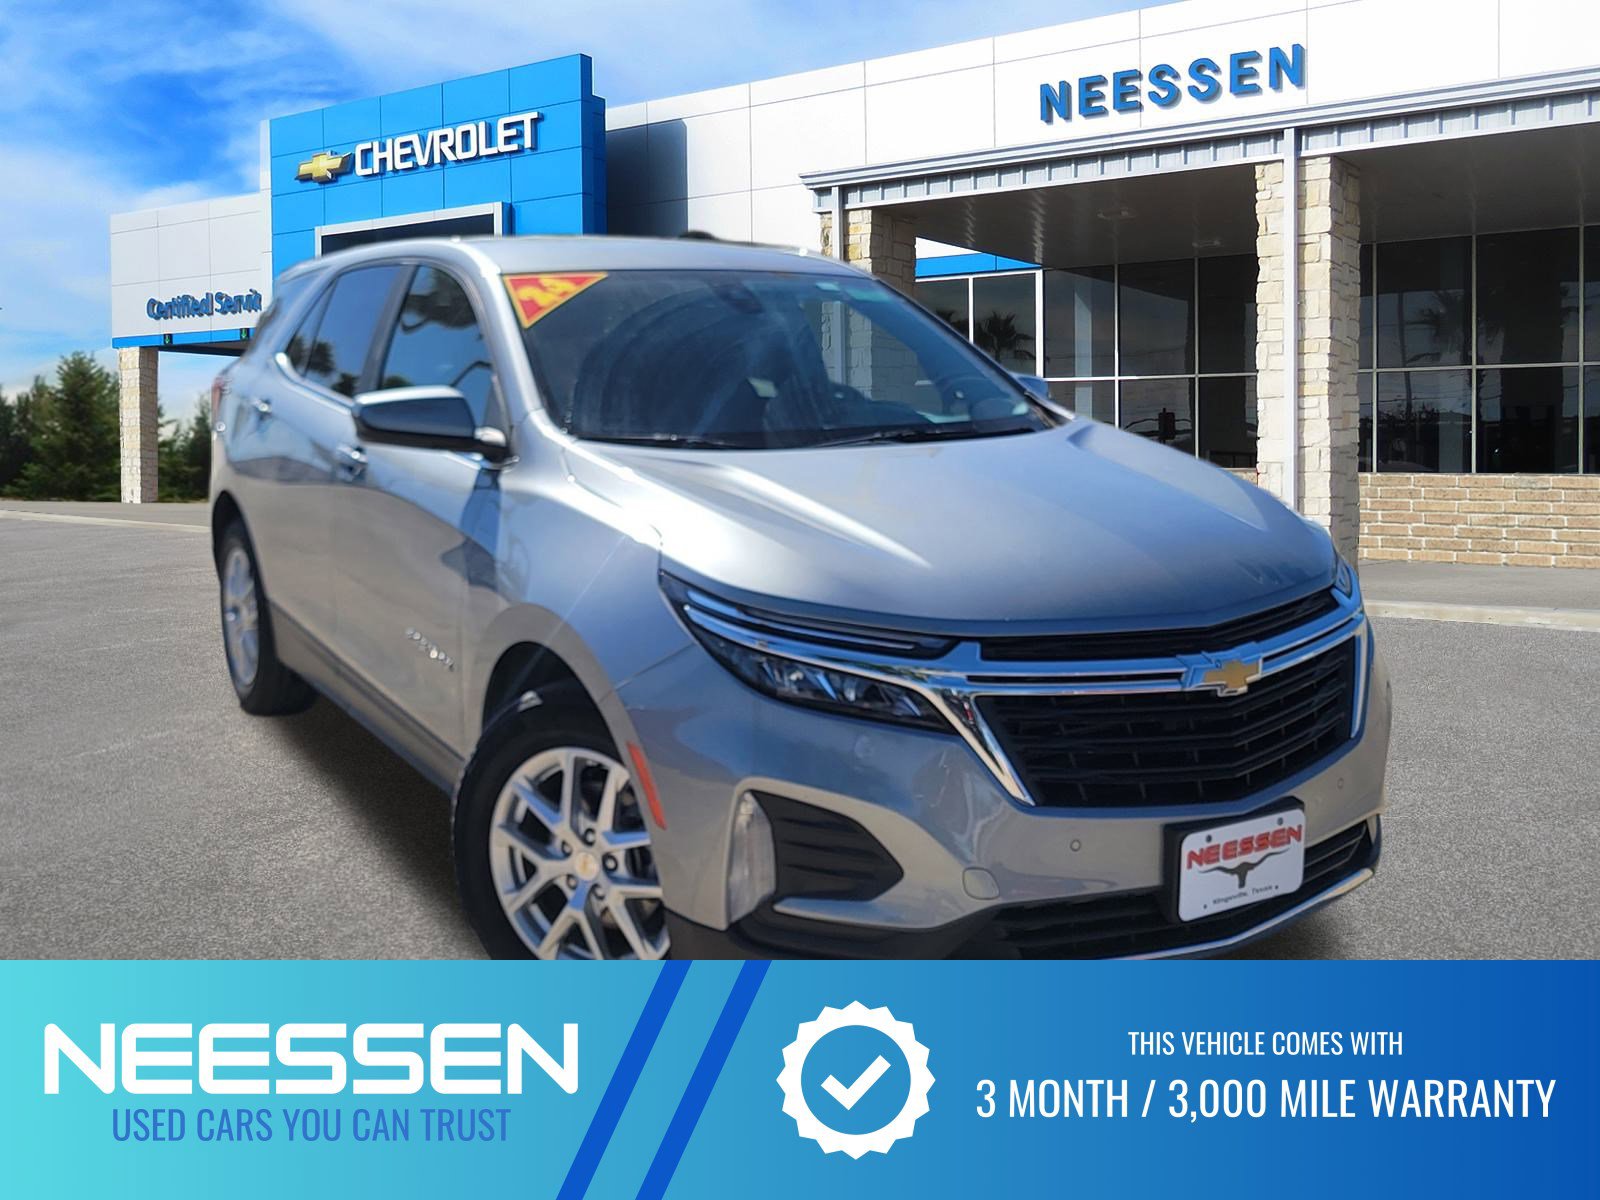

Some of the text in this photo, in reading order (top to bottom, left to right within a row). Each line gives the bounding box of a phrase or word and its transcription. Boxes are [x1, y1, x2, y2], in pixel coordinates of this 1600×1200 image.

[1040, 43, 1305, 124] NEESSEN
[354, 111, 544, 177] CHEVROLET
[147, 292, 214, 320] Certified
[1186, 824, 1303, 870] NEESSEN
